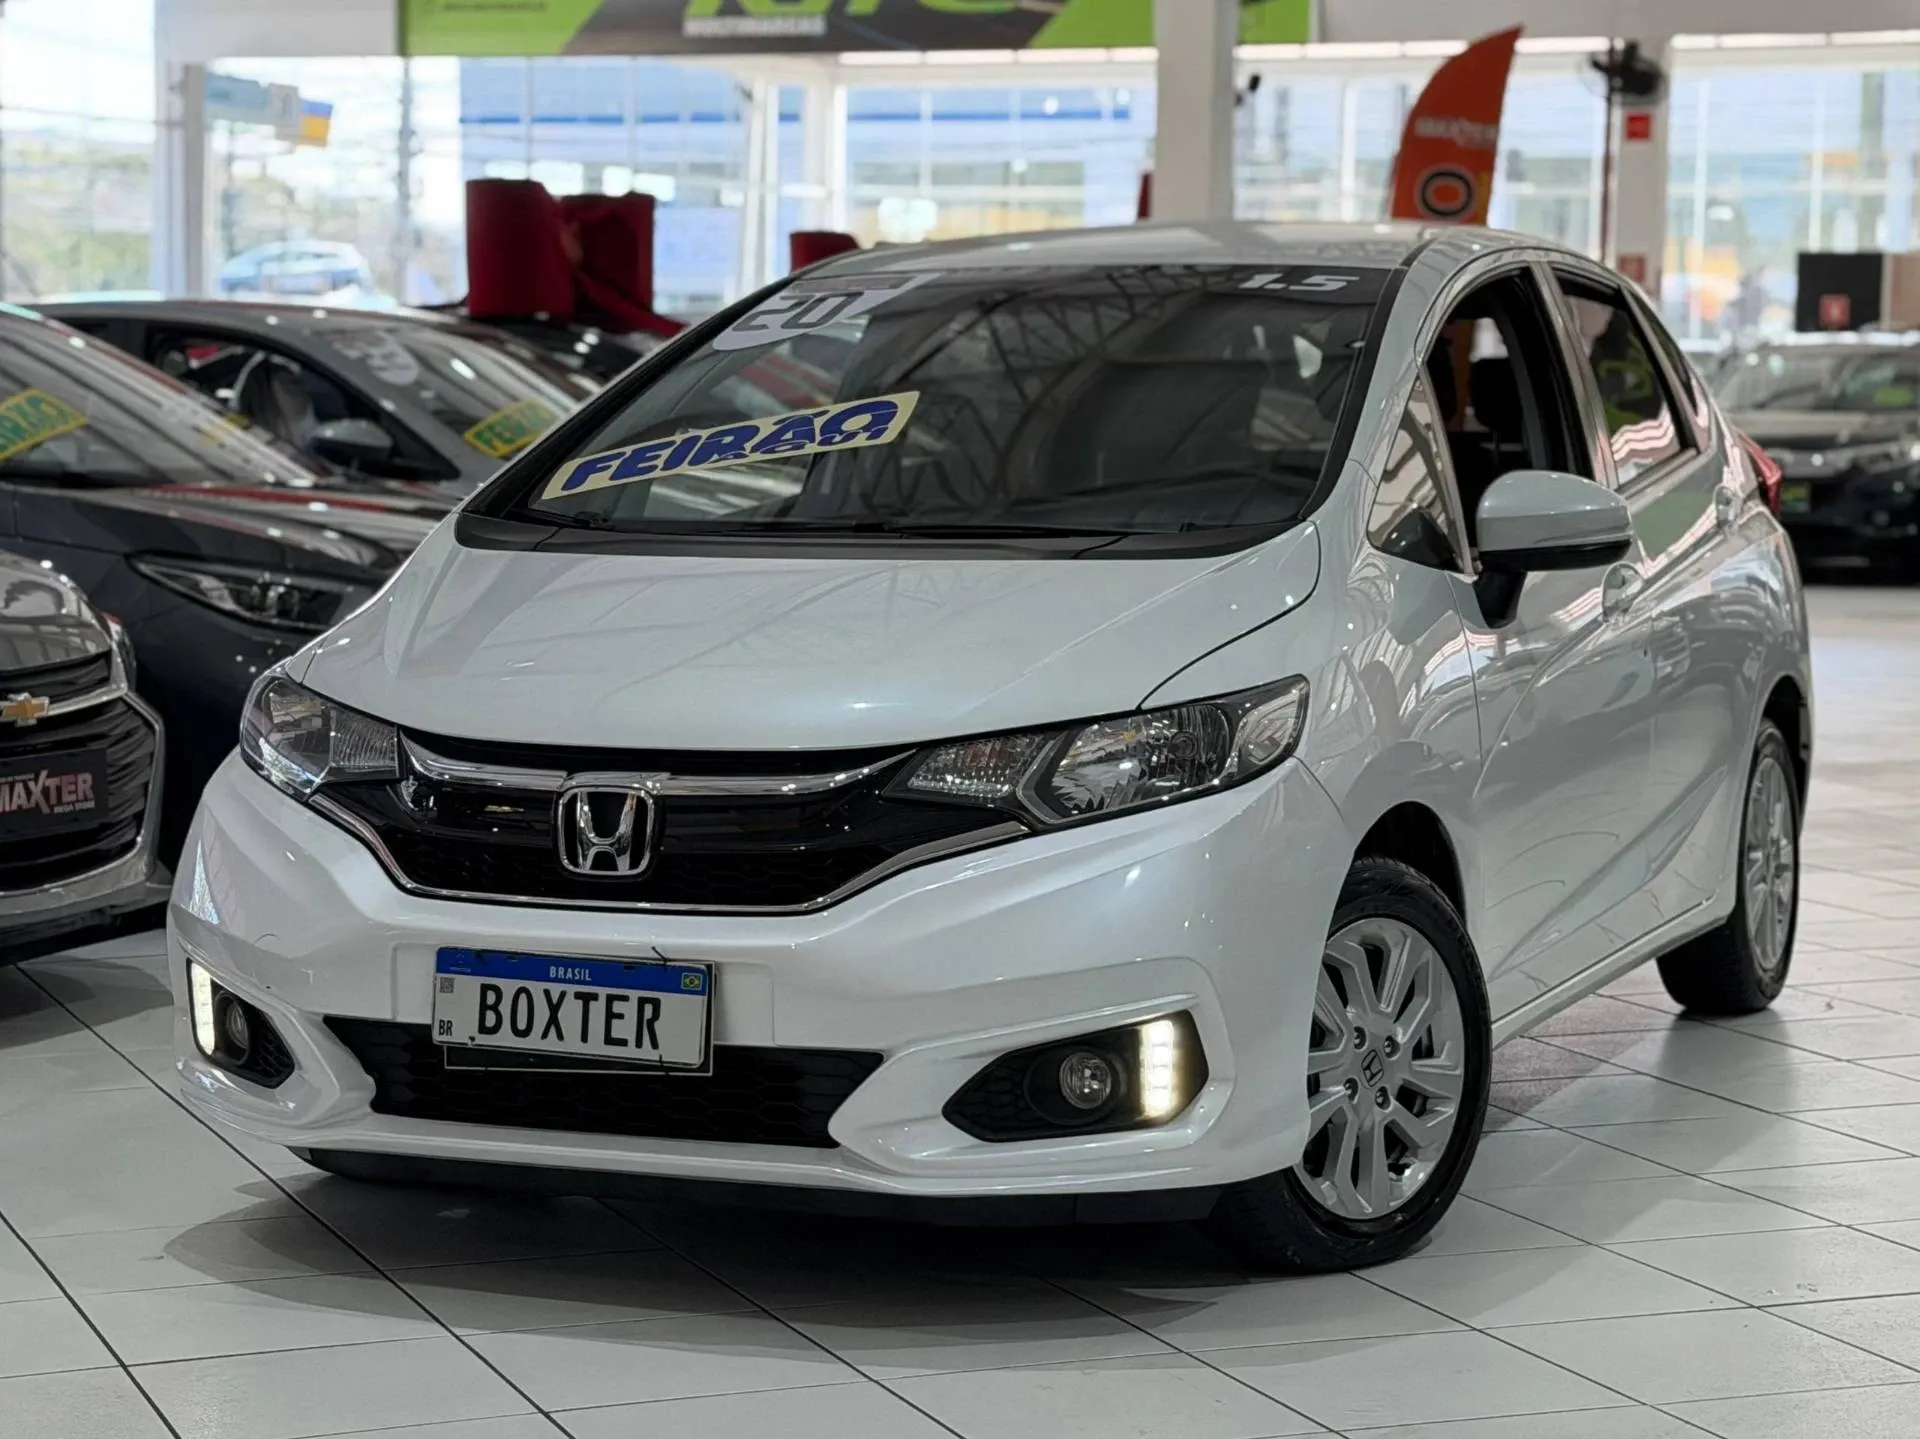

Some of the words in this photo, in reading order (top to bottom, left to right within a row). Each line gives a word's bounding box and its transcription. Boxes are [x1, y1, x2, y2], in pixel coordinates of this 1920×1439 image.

[1238, 272, 1360, 291] 1.5
[549, 965, 592, 981] BRASIL
[477, 983, 662, 1050] BOXTER
[438, 1019, 453, 1037] BR
